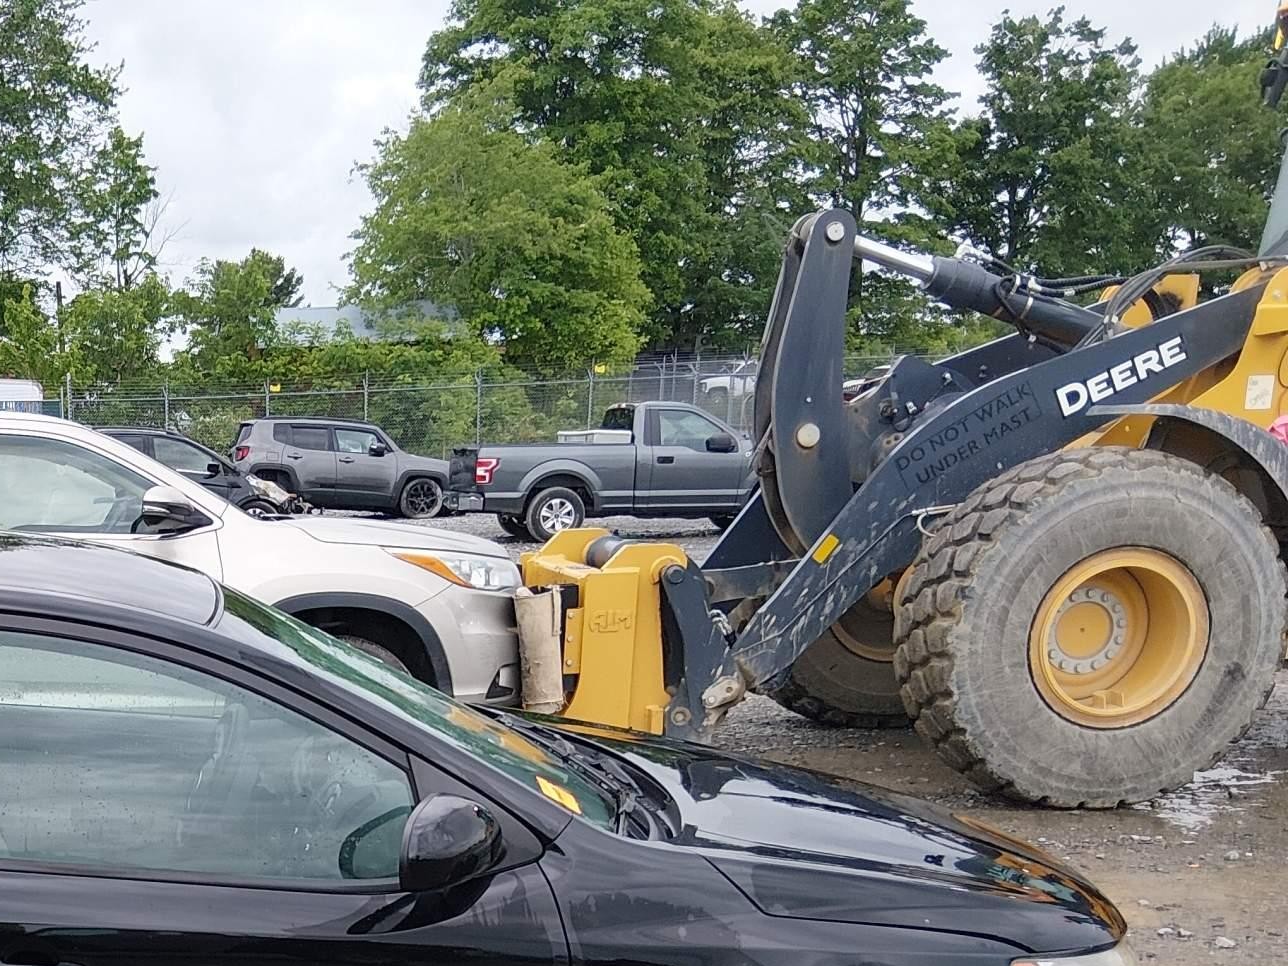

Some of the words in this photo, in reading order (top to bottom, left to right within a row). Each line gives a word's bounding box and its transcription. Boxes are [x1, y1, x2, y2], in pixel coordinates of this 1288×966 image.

[1055, 335, 1188, 418] DEERE
[894, 446, 926, 472] DO
[929, 417, 970, 451] NOT
[974, 383, 1031, 422] WALK
[915, 439, 981, 484] UNDER
[983, 406, 1033, 446] MAST
